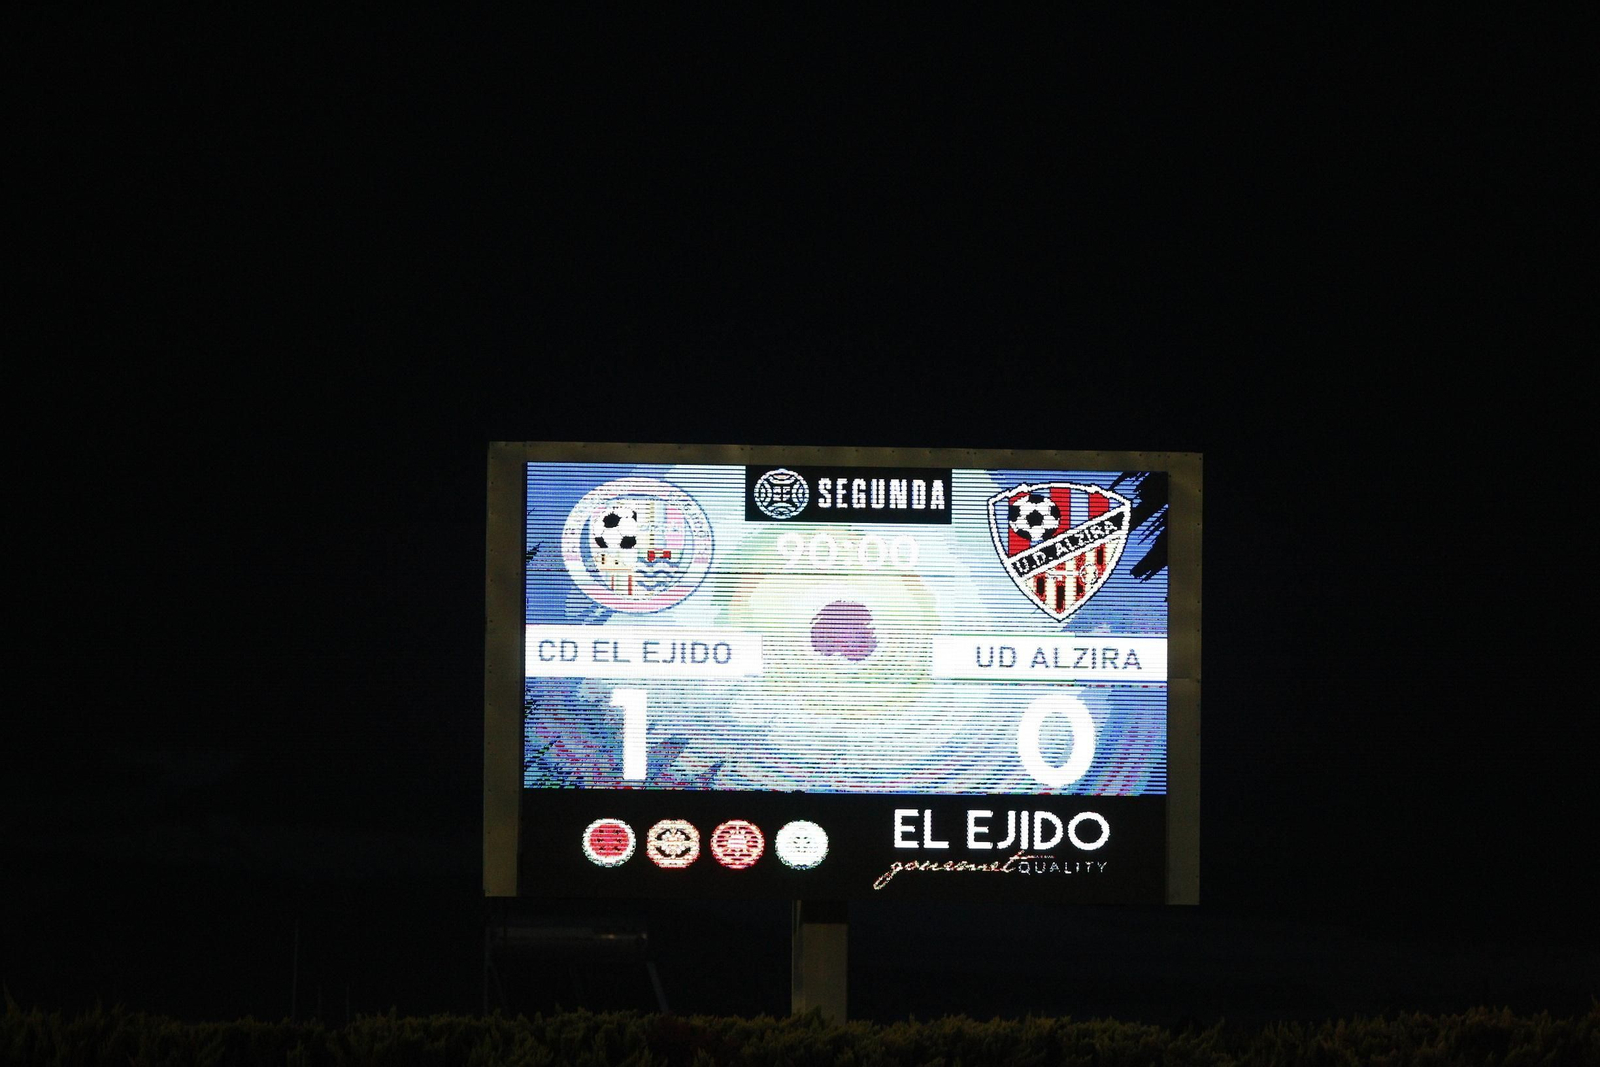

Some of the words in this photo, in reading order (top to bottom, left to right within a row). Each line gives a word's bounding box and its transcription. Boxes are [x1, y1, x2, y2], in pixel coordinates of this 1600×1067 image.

[817, 477, 945, 510] SEGUNDA
[776, 531, 919, 570] 90:00
[538, 639, 579, 662] CD
[592, 640, 631, 663] EL
[643, 641, 732, 665] EJIDO
[976, 646, 1017, 668] UD
[1029, 647, 1143, 670] ALZIRA
[609, 688, 648, 780] 1
[1017, 693, 1097, 788] 0
[893, 808, 950, 849] EL
[966, 809, 1111, 851] EJIDO
[1018, 860, 1108, 876] QUALITY
